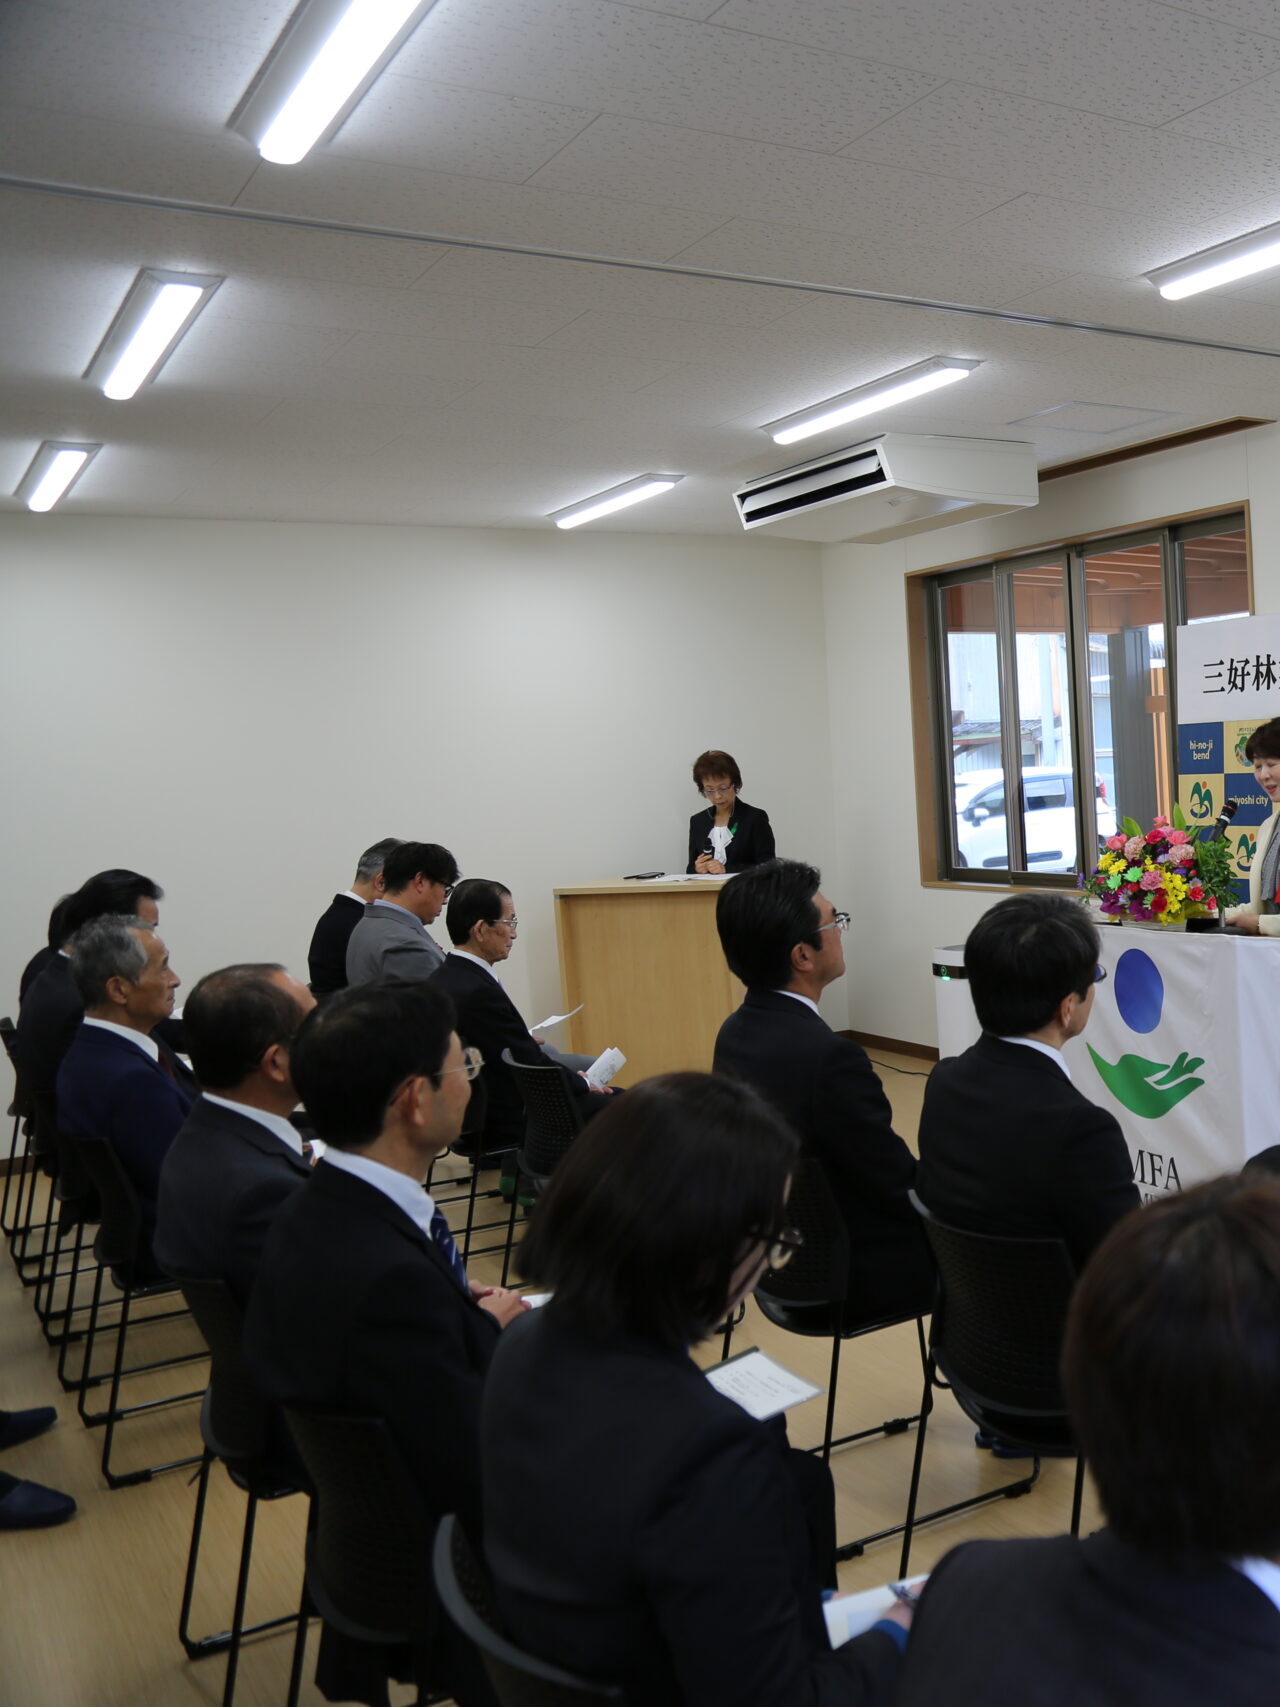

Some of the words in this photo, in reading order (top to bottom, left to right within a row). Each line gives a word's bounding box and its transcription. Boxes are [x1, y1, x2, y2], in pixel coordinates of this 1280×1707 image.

[1189, 739, 1213, 751] hi-no-ji
[1192, 750, 1210, 761] bend
[1255, 794, 1269, 807] city
